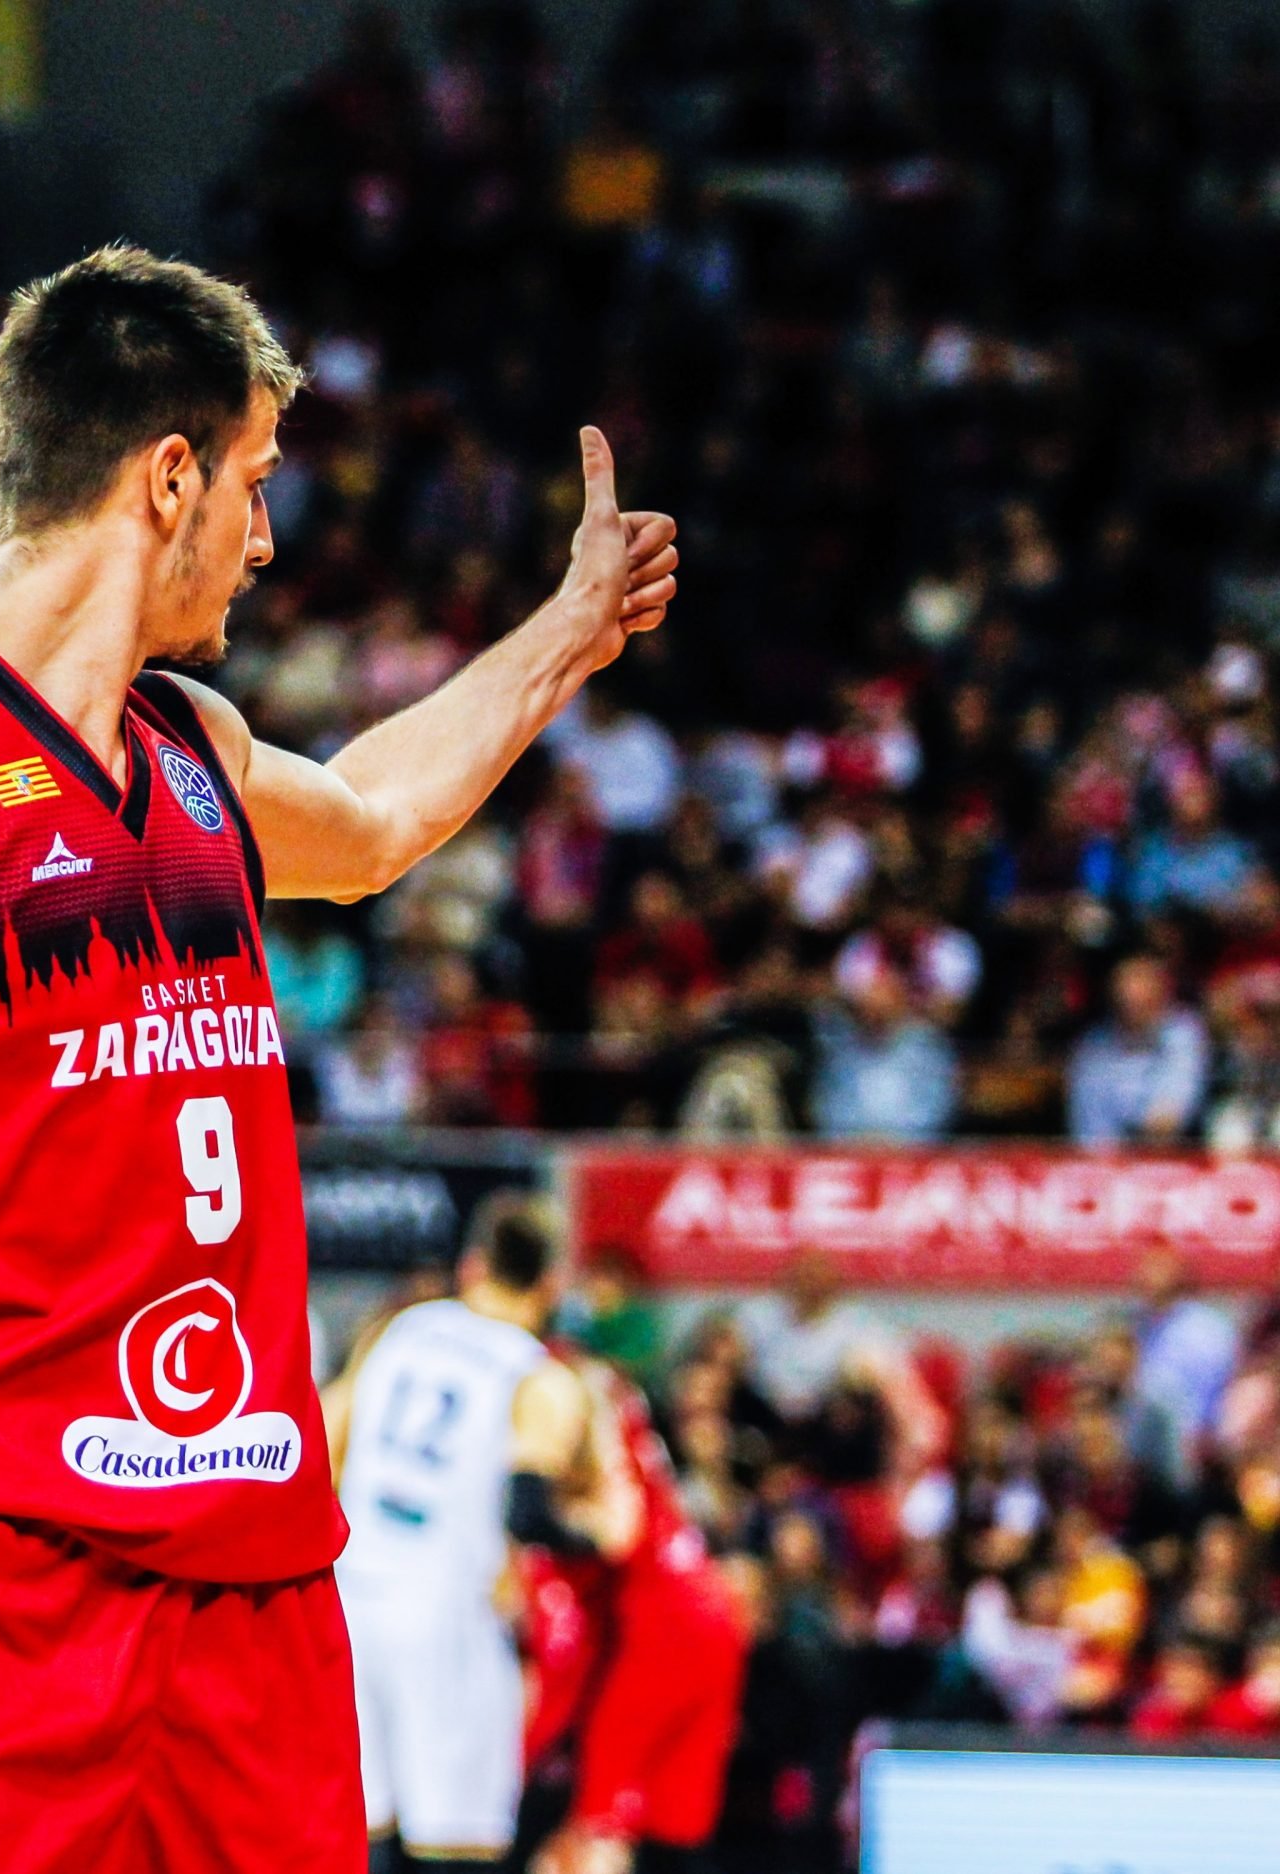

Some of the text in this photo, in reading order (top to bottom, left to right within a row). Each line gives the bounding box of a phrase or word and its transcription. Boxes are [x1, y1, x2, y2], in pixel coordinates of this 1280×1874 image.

[32, 857, 93, 882] MERCURY
[141, 974, 226, 1011] BASKET
[49, 1005, 285, 1088] ZARAGOZA
[176, 1096, 242, 1245] 9
[74, 1435, 293, 1479] Casademont
